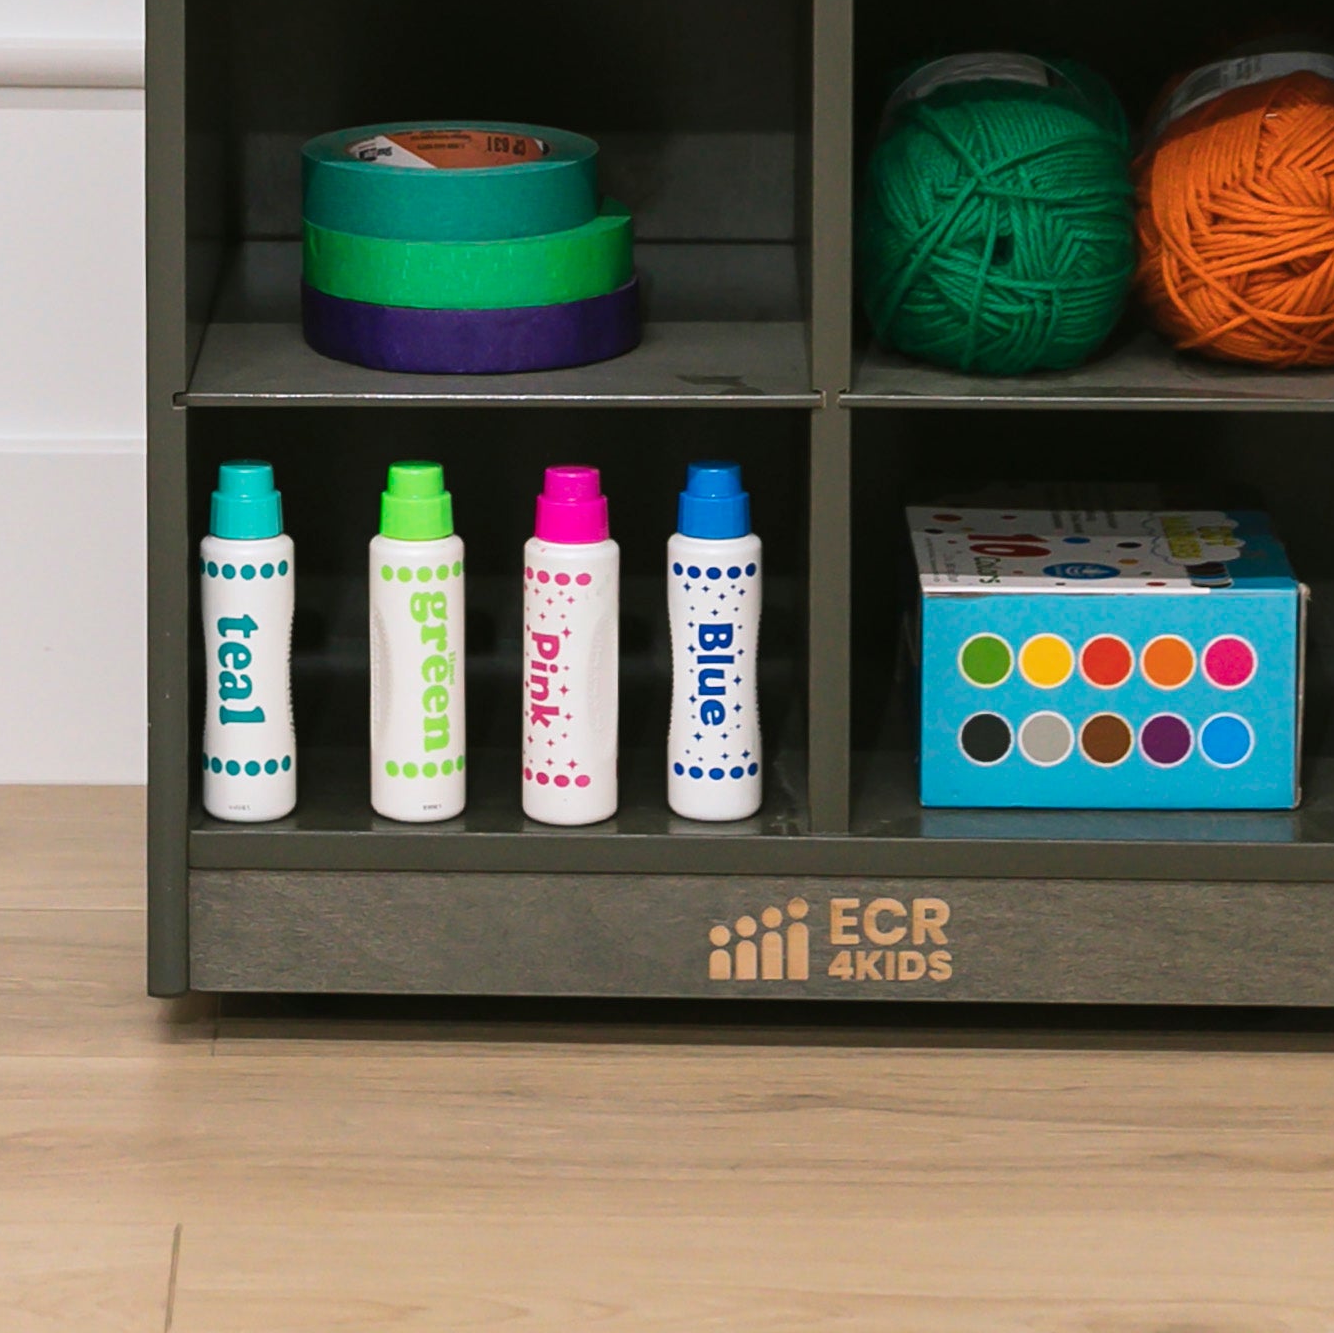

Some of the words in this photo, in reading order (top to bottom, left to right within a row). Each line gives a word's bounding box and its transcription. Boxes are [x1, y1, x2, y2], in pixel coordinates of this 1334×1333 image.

[967, 534, 1052, 558] 10
[217, 614, 265, 725] teal
[410, 591, 450, 752] green
[530, 631, 561, 729] Pink
[697, 623, 735, 727] Blue
[828, 950, 953, 982] 4KIDS
[829, 898, 950, 946] ECR
